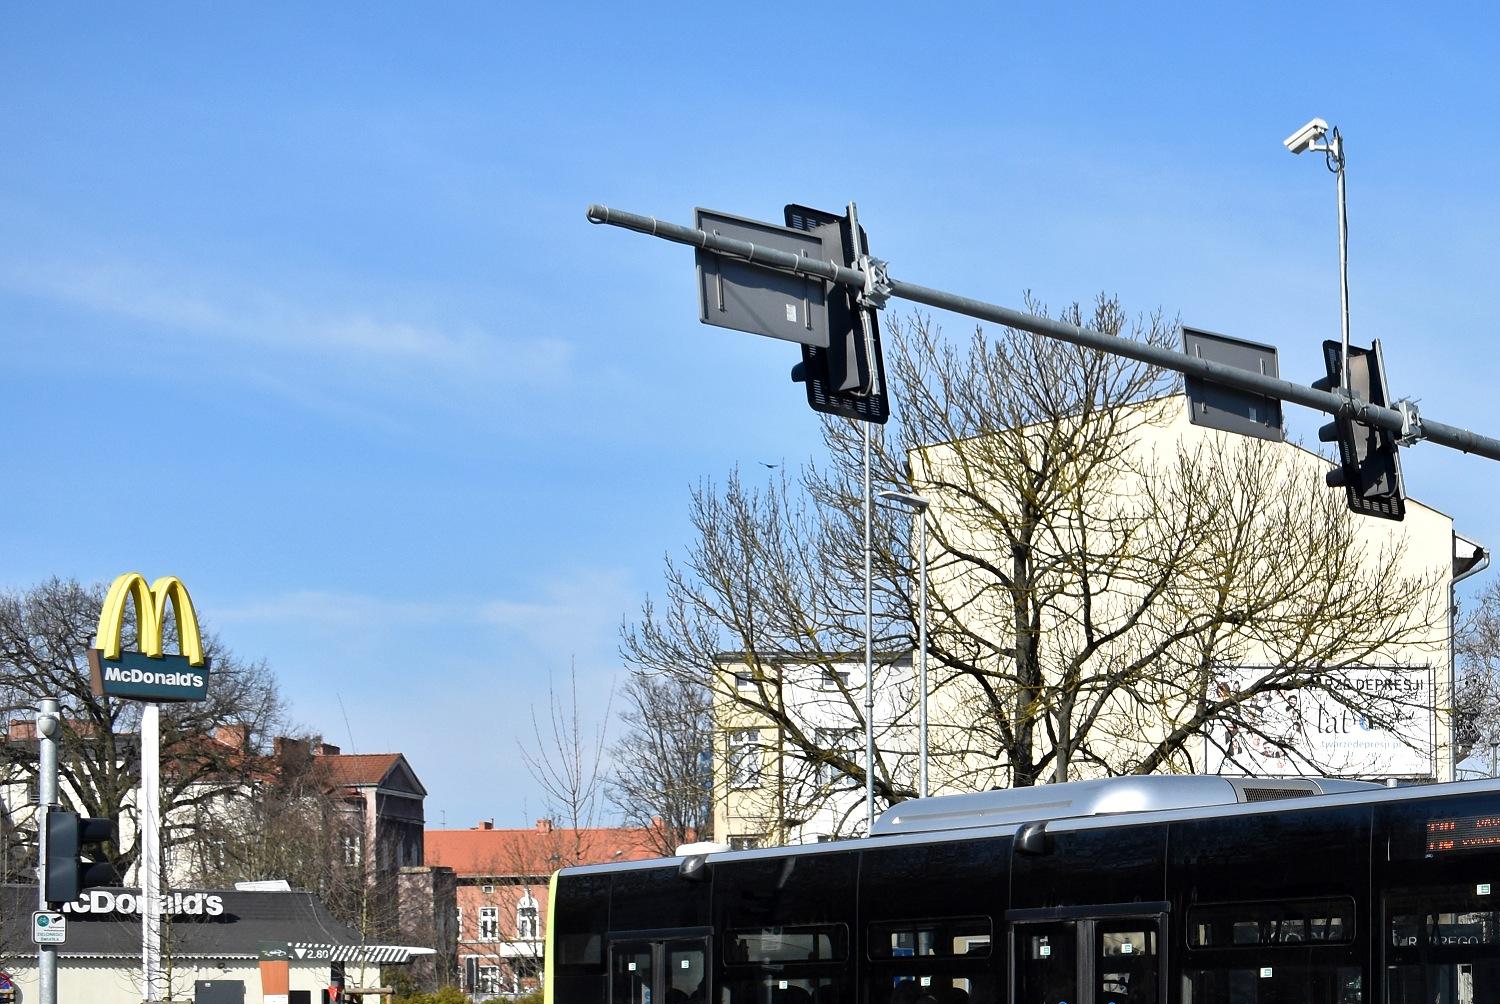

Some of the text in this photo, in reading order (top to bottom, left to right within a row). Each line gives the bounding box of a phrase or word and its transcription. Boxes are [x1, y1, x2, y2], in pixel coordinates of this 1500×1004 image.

[104, 667, 204, 688] McDonald's
[1356, 678, 1424, 692] DEPRESJI
[306, 949, 329, 959] 2.80
